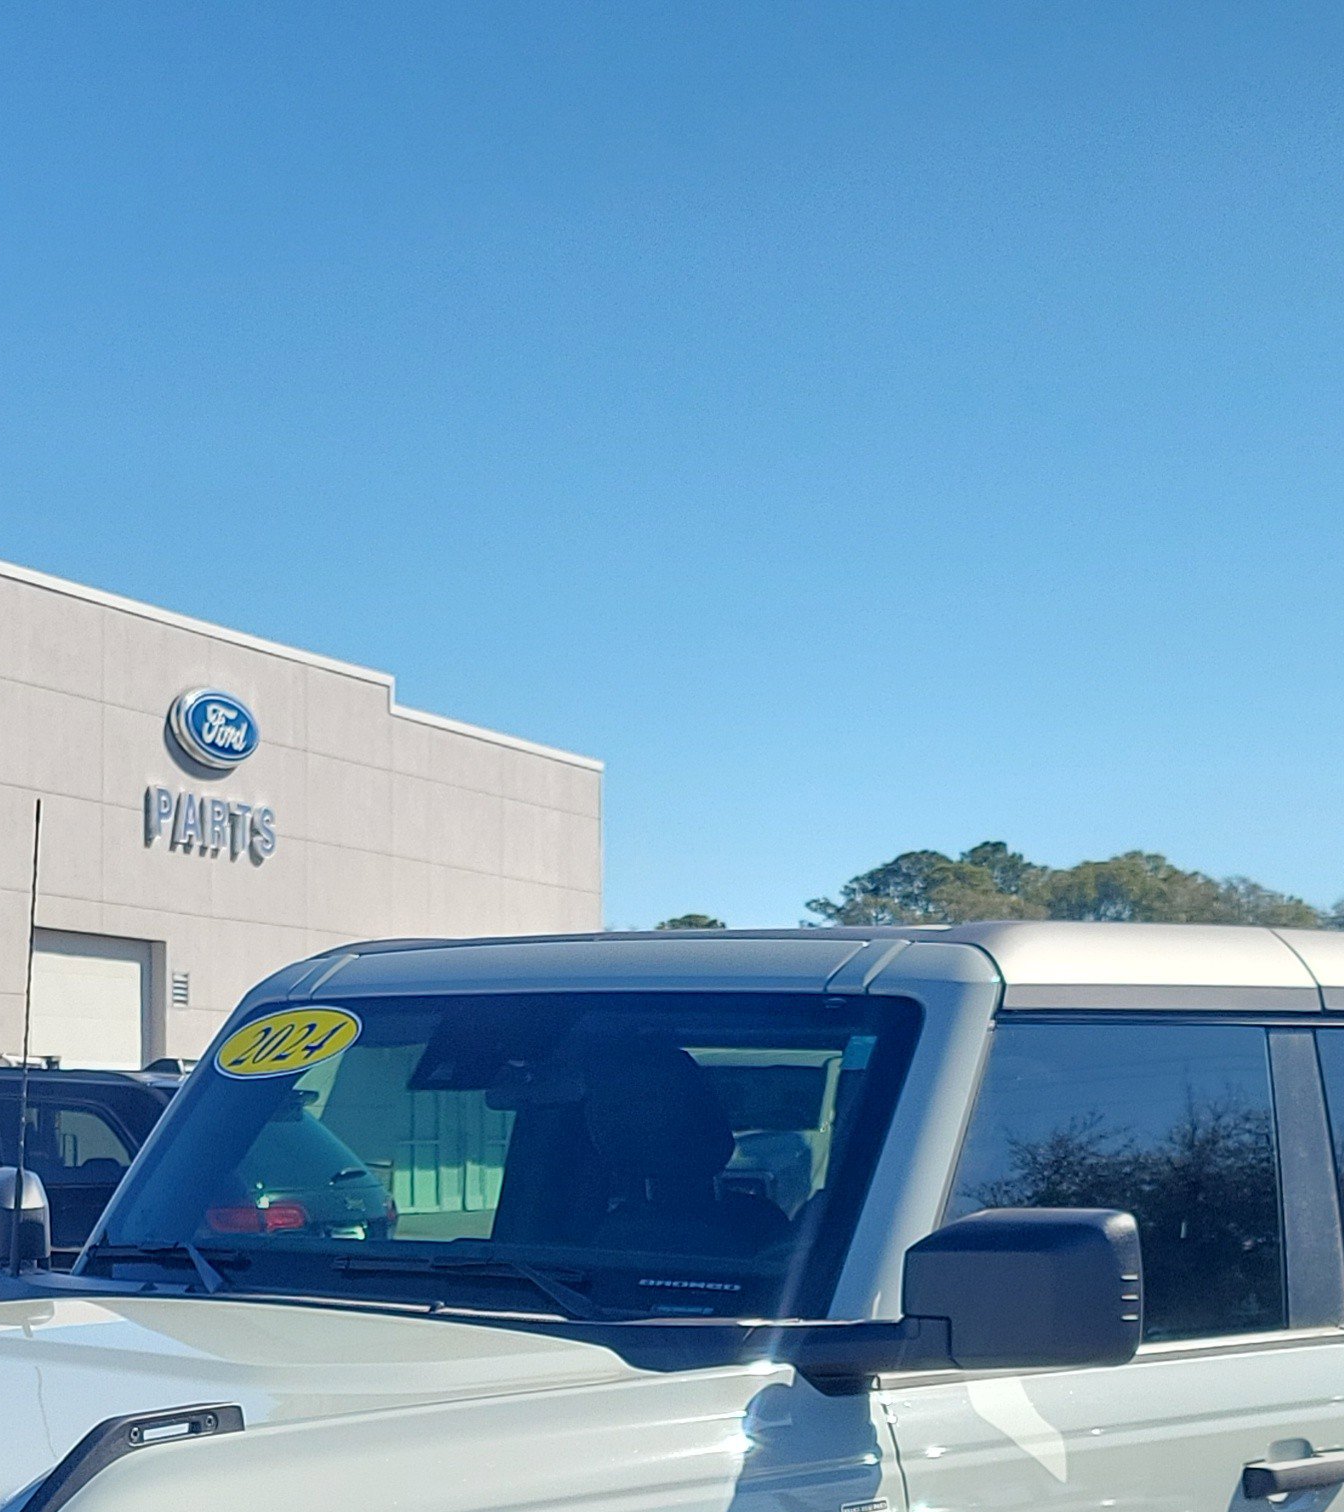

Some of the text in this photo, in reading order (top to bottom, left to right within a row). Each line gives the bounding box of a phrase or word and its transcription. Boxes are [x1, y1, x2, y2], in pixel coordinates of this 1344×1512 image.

[202, 703, 248, 752] Ford
[147, 784, 277, 859] PARTS
[227, 1020, 349, 1068] 2024
